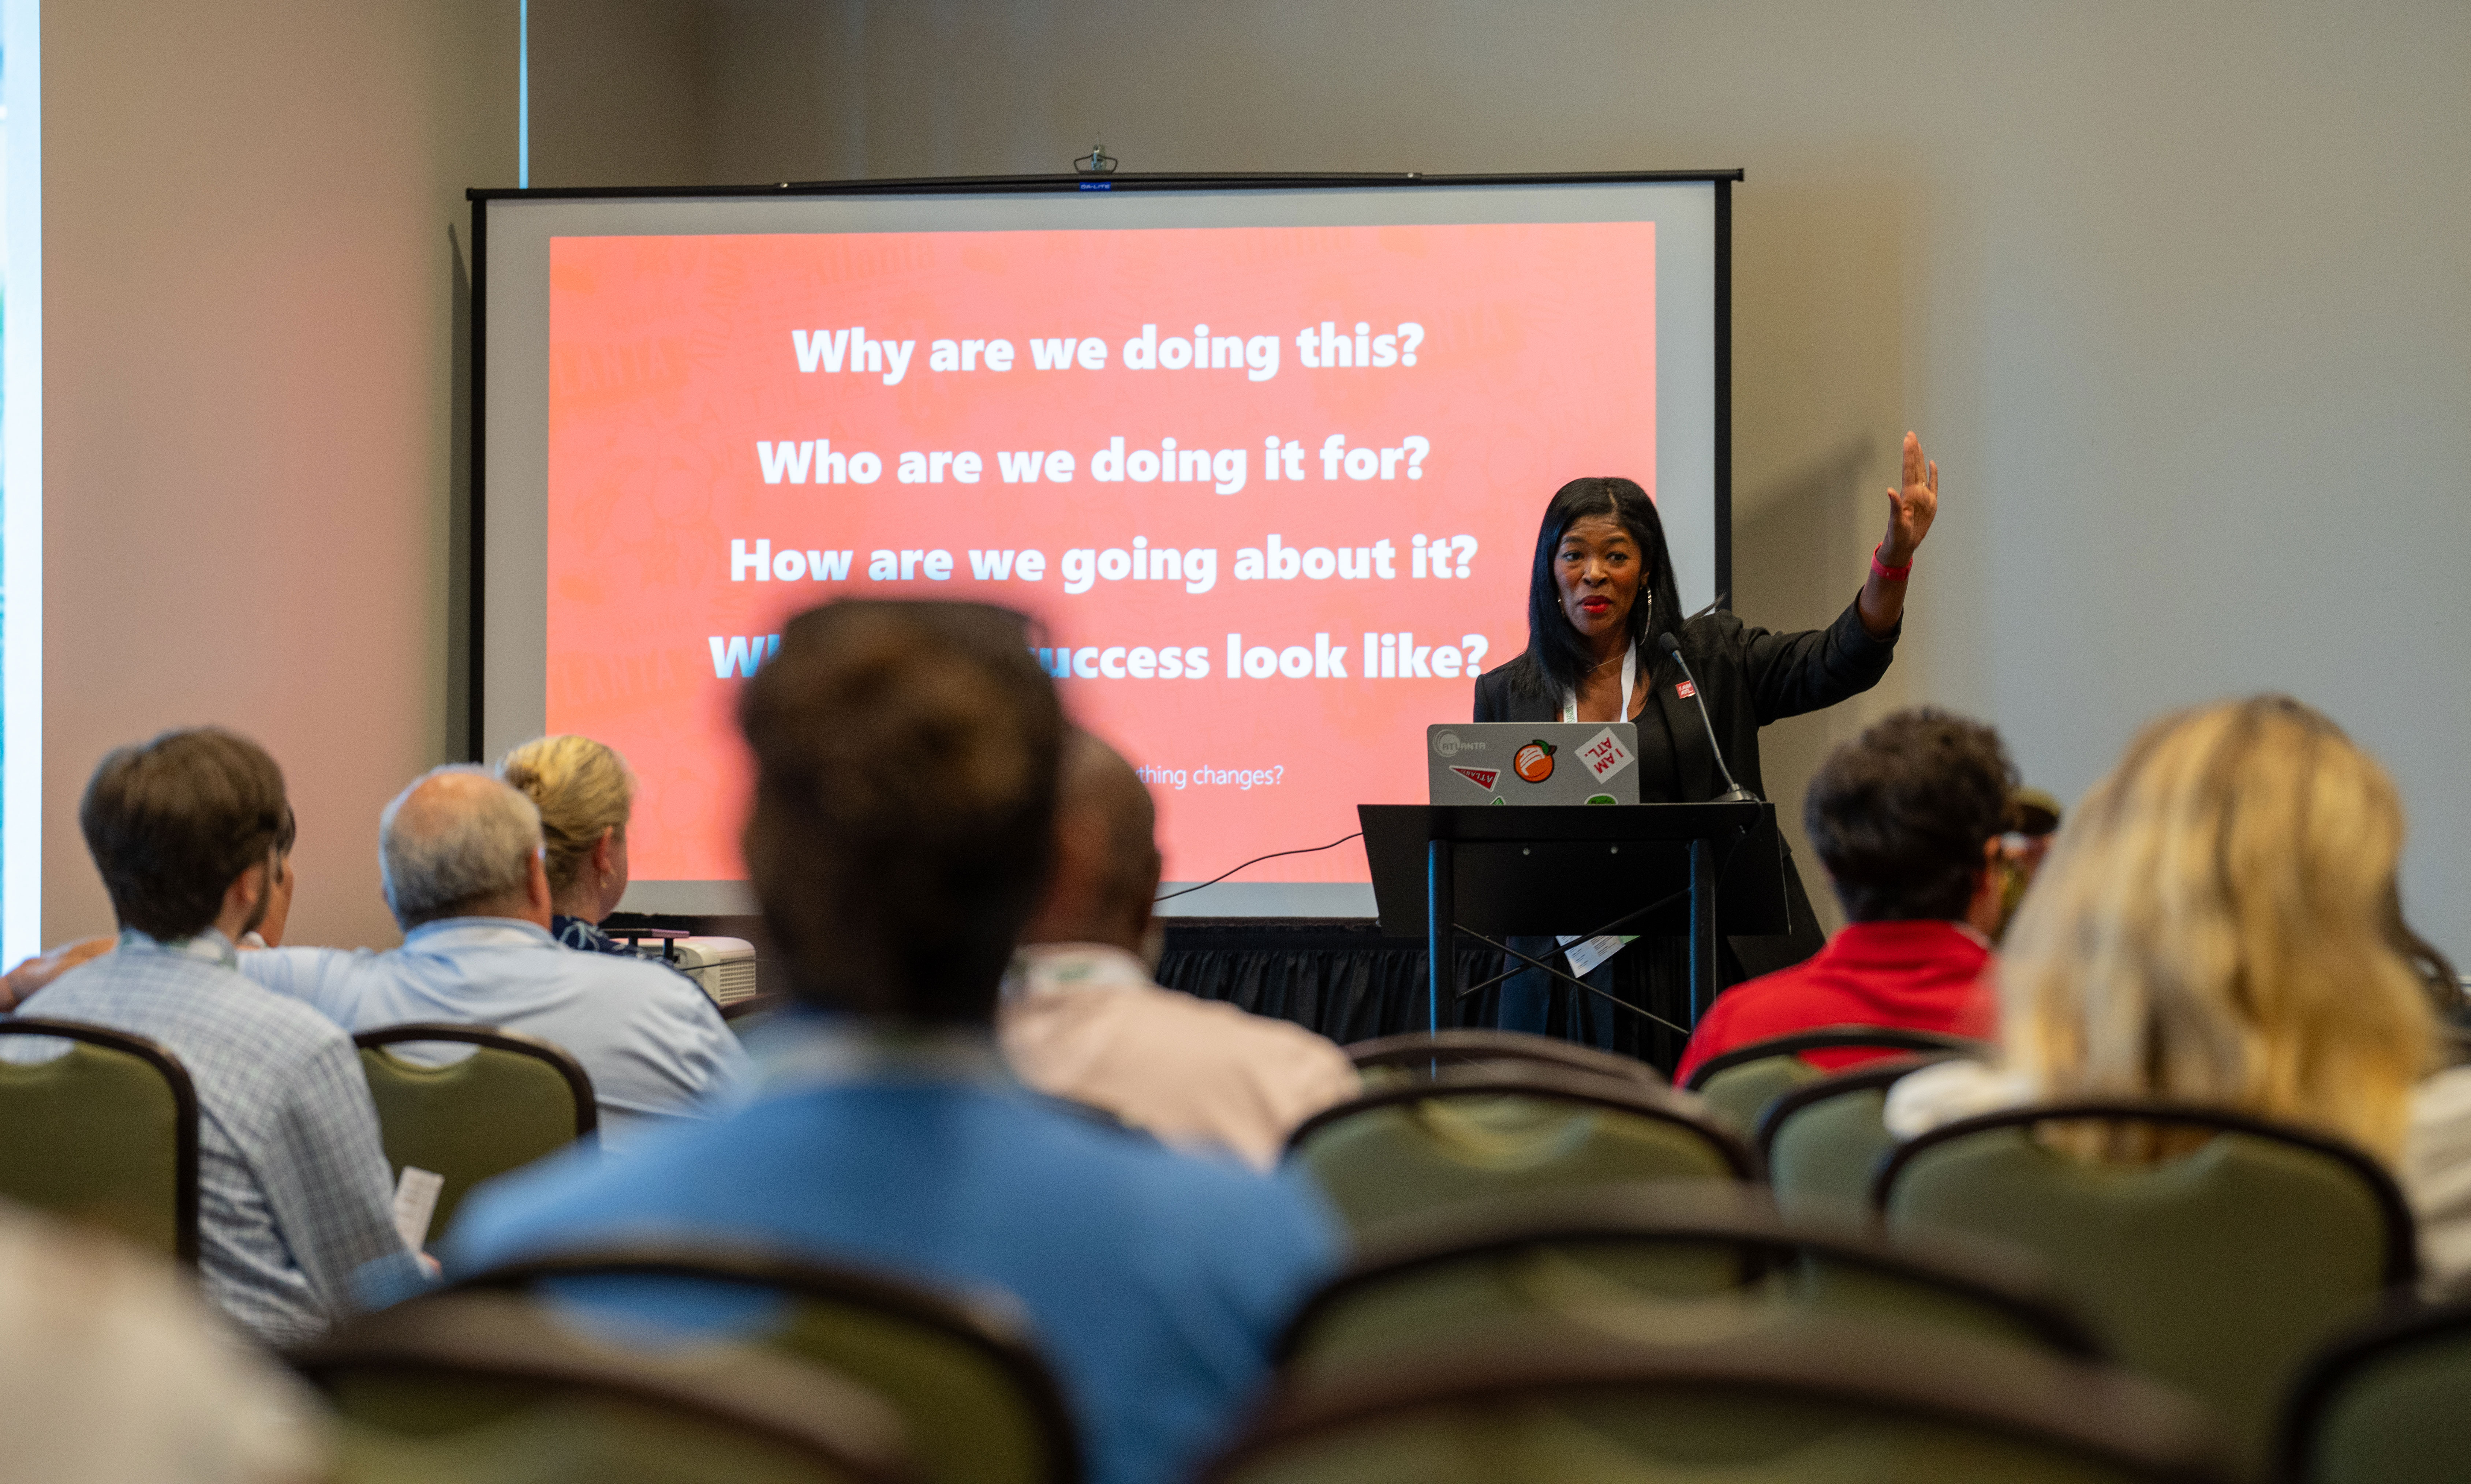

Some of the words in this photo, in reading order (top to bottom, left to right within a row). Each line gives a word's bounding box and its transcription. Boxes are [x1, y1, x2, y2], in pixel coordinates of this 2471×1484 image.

[792, 326, 916, 386] Why
[929, 338, 1015, 372] are
[1029, 337, 1108, 371] we
[1122, 323, 1281, 382] doing
[1295, 321, 1425, 368] this?
[756, 439, 882, 484] Who
[897, 451, 983, 484] are
[997, 450, 1076, 483] we
[1090, 436, 1248, 495] doing
[1264, 435, 1305, 481] it
[1319, 434, 1431, 481] for?
[730, 539, 853, 582] How
[868, 549, 954, 581] are
[968, 549, 1046, 581] we
[1061, 535, 1218, 595] going
[1233, 533, 1396, 581] about
[1412, 533, 1479, 579] it?
[1029, 646, 1211, 679] uccess
[1226, 632, 1348, 679] look
[1364, 632, 1489, 679] like?
[1442, 742, 1485, 750] ATLANTA
[1584, 737, 1612, 758] ATL.
[1615, 748, 1624, 758] I
[1594, 752, 1615, 774] AM
[1136, 764, 1187, 790] thing
[1192, 764, 1285, 791] changes?
